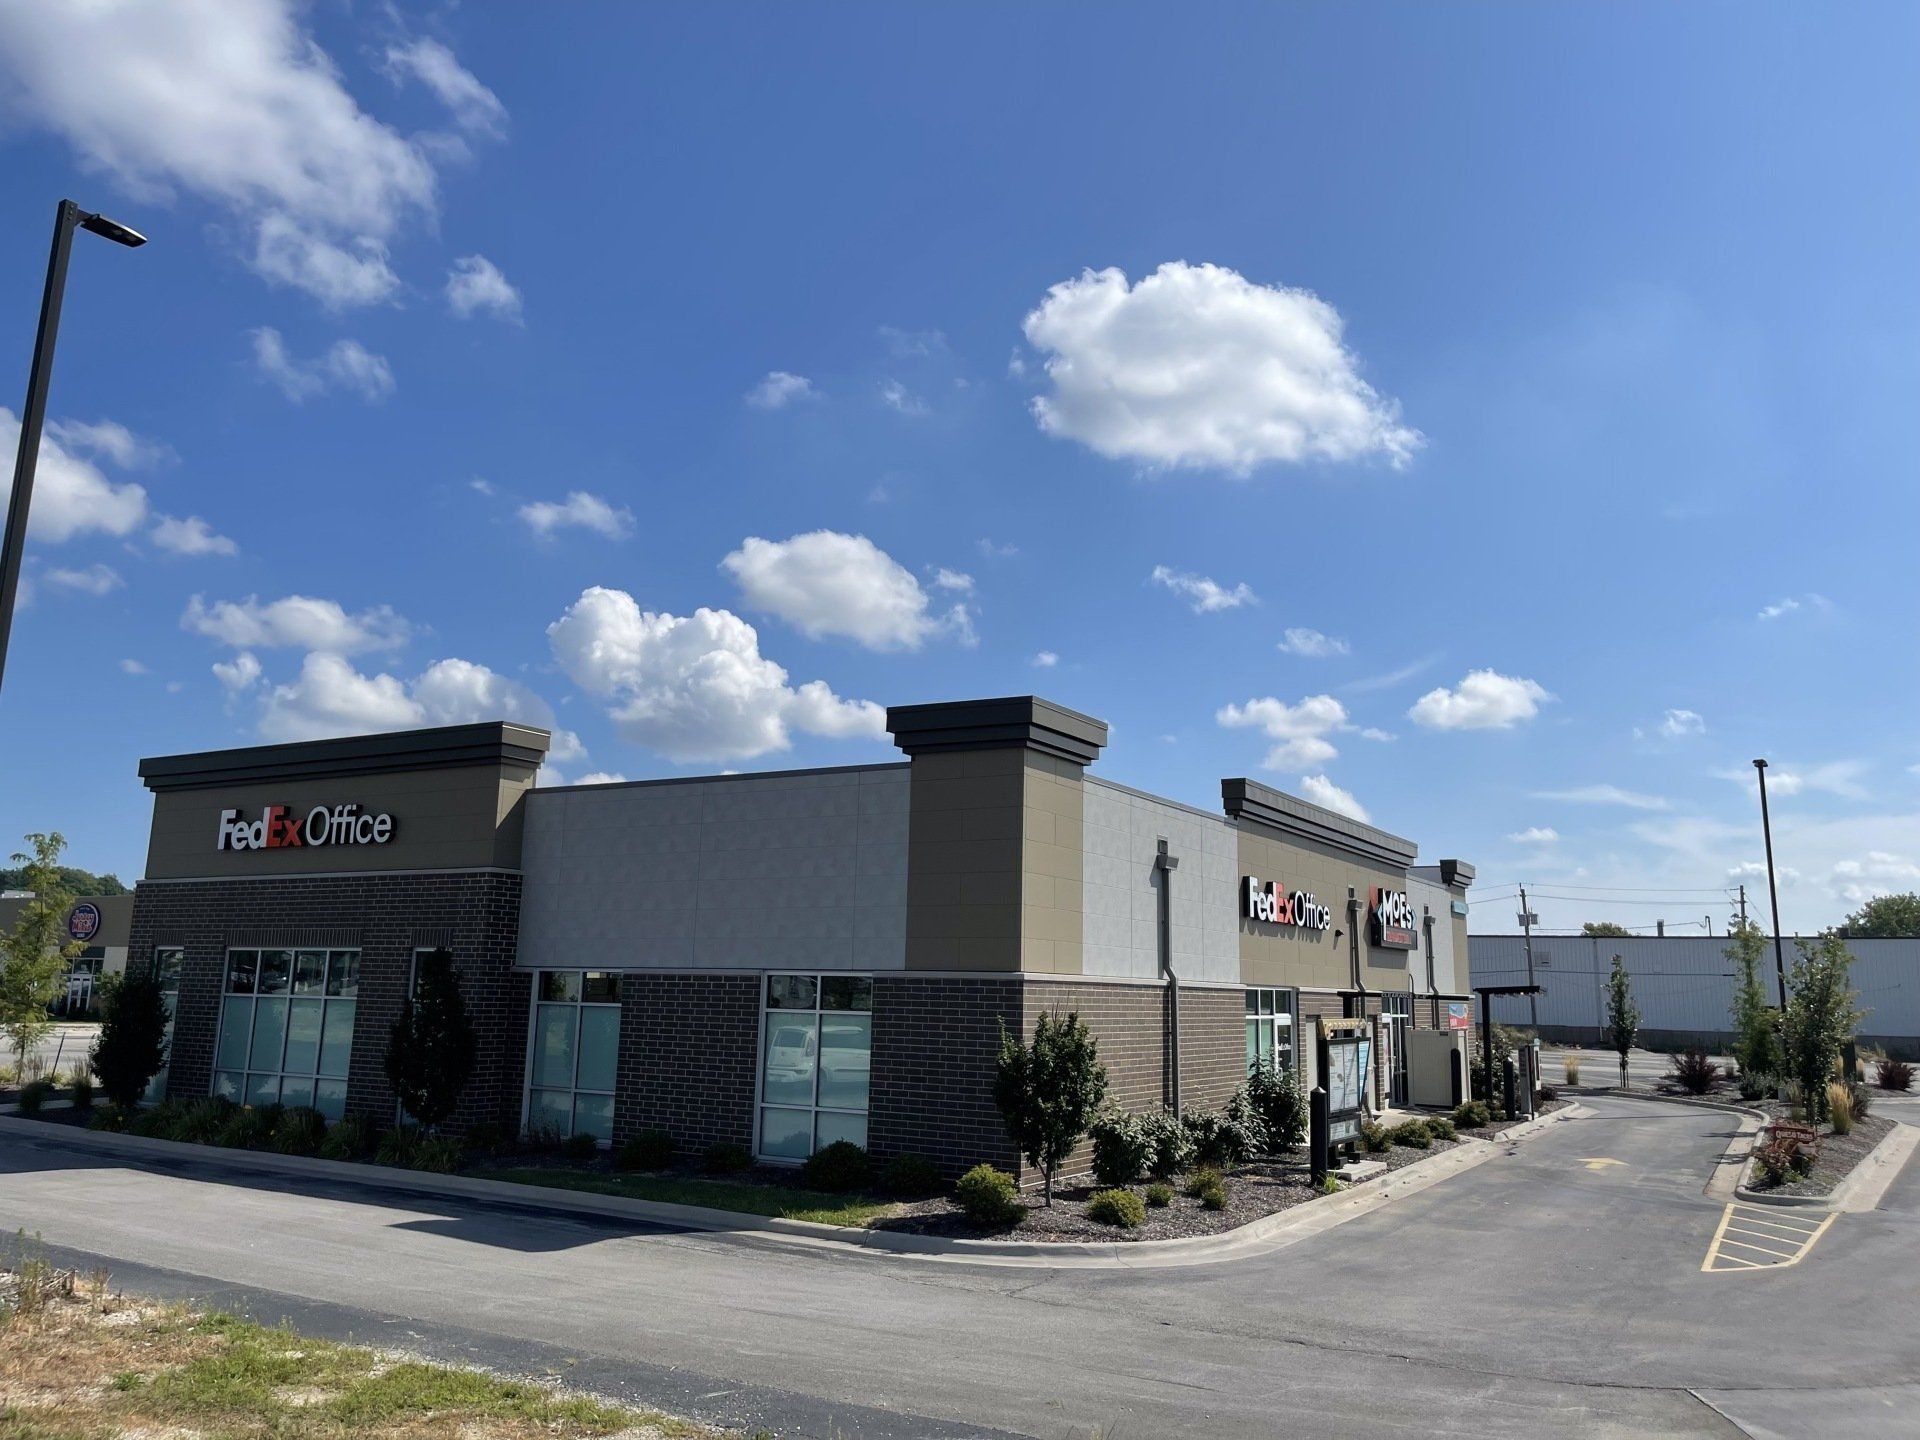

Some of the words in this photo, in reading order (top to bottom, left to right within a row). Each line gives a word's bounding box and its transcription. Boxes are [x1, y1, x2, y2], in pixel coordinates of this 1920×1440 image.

[218, 805, 303, 850] FedEx
[305, 804, 392, 846] Office
[1249, 876, 1295, 925] FedEx
[1295, 890, 1331, 930] Office
